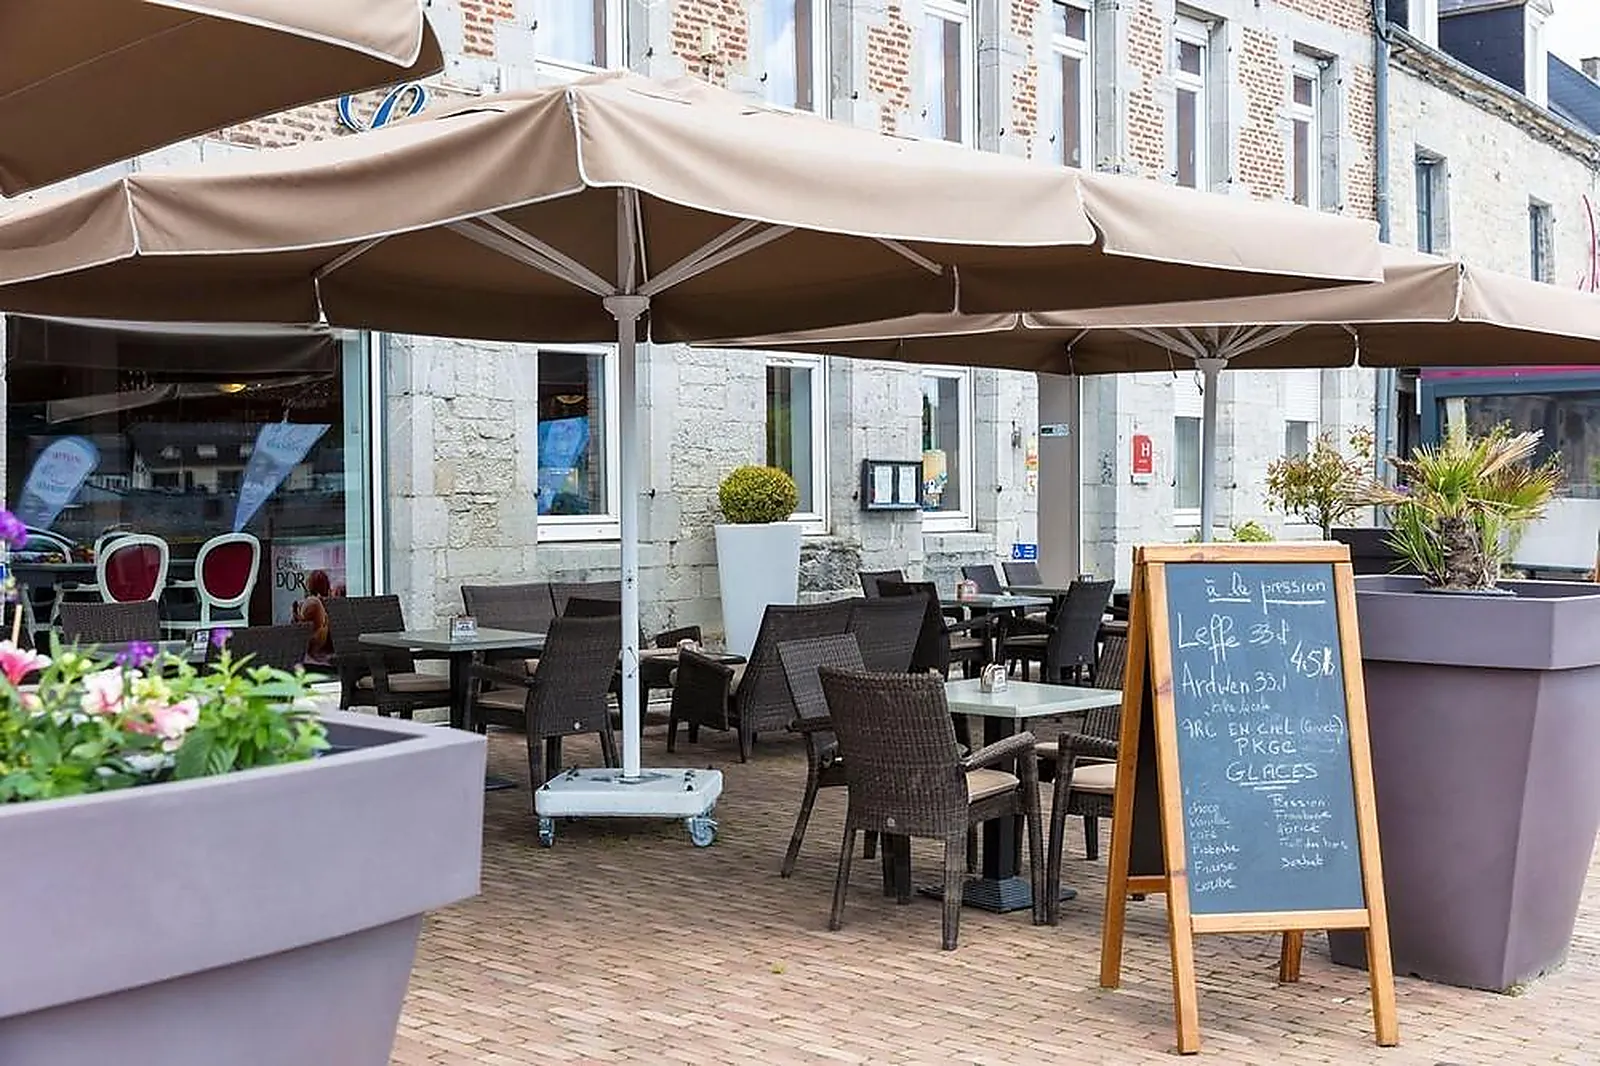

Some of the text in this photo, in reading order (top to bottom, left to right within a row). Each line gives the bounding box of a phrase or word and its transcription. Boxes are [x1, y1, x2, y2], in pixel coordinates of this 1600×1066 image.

[1141, 442, 1150, 457] H
[1260, 580, 1326, 615] pression
[1177, 612, 1241, 664] Leffe
[1228, 722, 1250, 737] EN
[1226, 761, 1319, 781] GLACES
